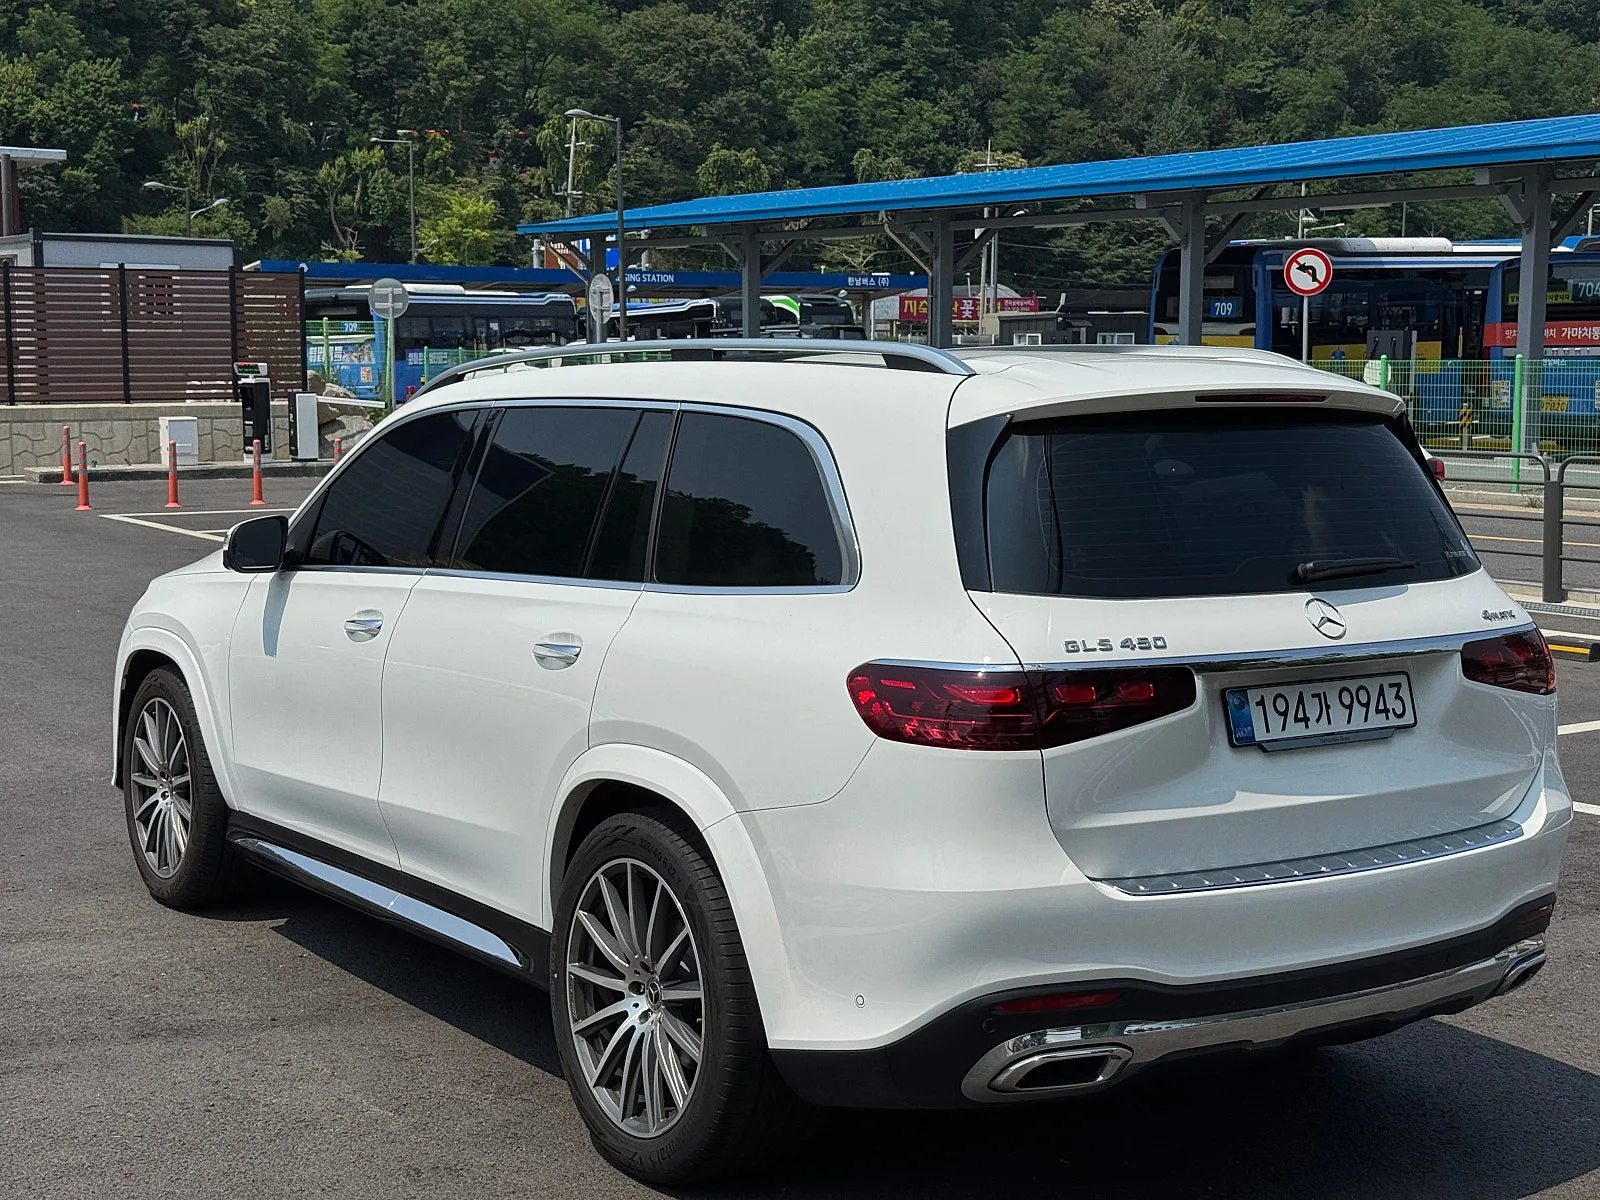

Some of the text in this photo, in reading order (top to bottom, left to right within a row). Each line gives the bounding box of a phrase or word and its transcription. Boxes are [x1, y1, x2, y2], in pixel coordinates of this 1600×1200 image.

[642, 274, 675, 282] STATION
[848, 276, 889, 287] 한남버스 (주)
[1214, 302, 1233, 316] 709
[344, 322, 358, 332] 709
[1064, 636, 1168, 654] GLS 450
[1255, 681, 1407, 734] 194가 9943
